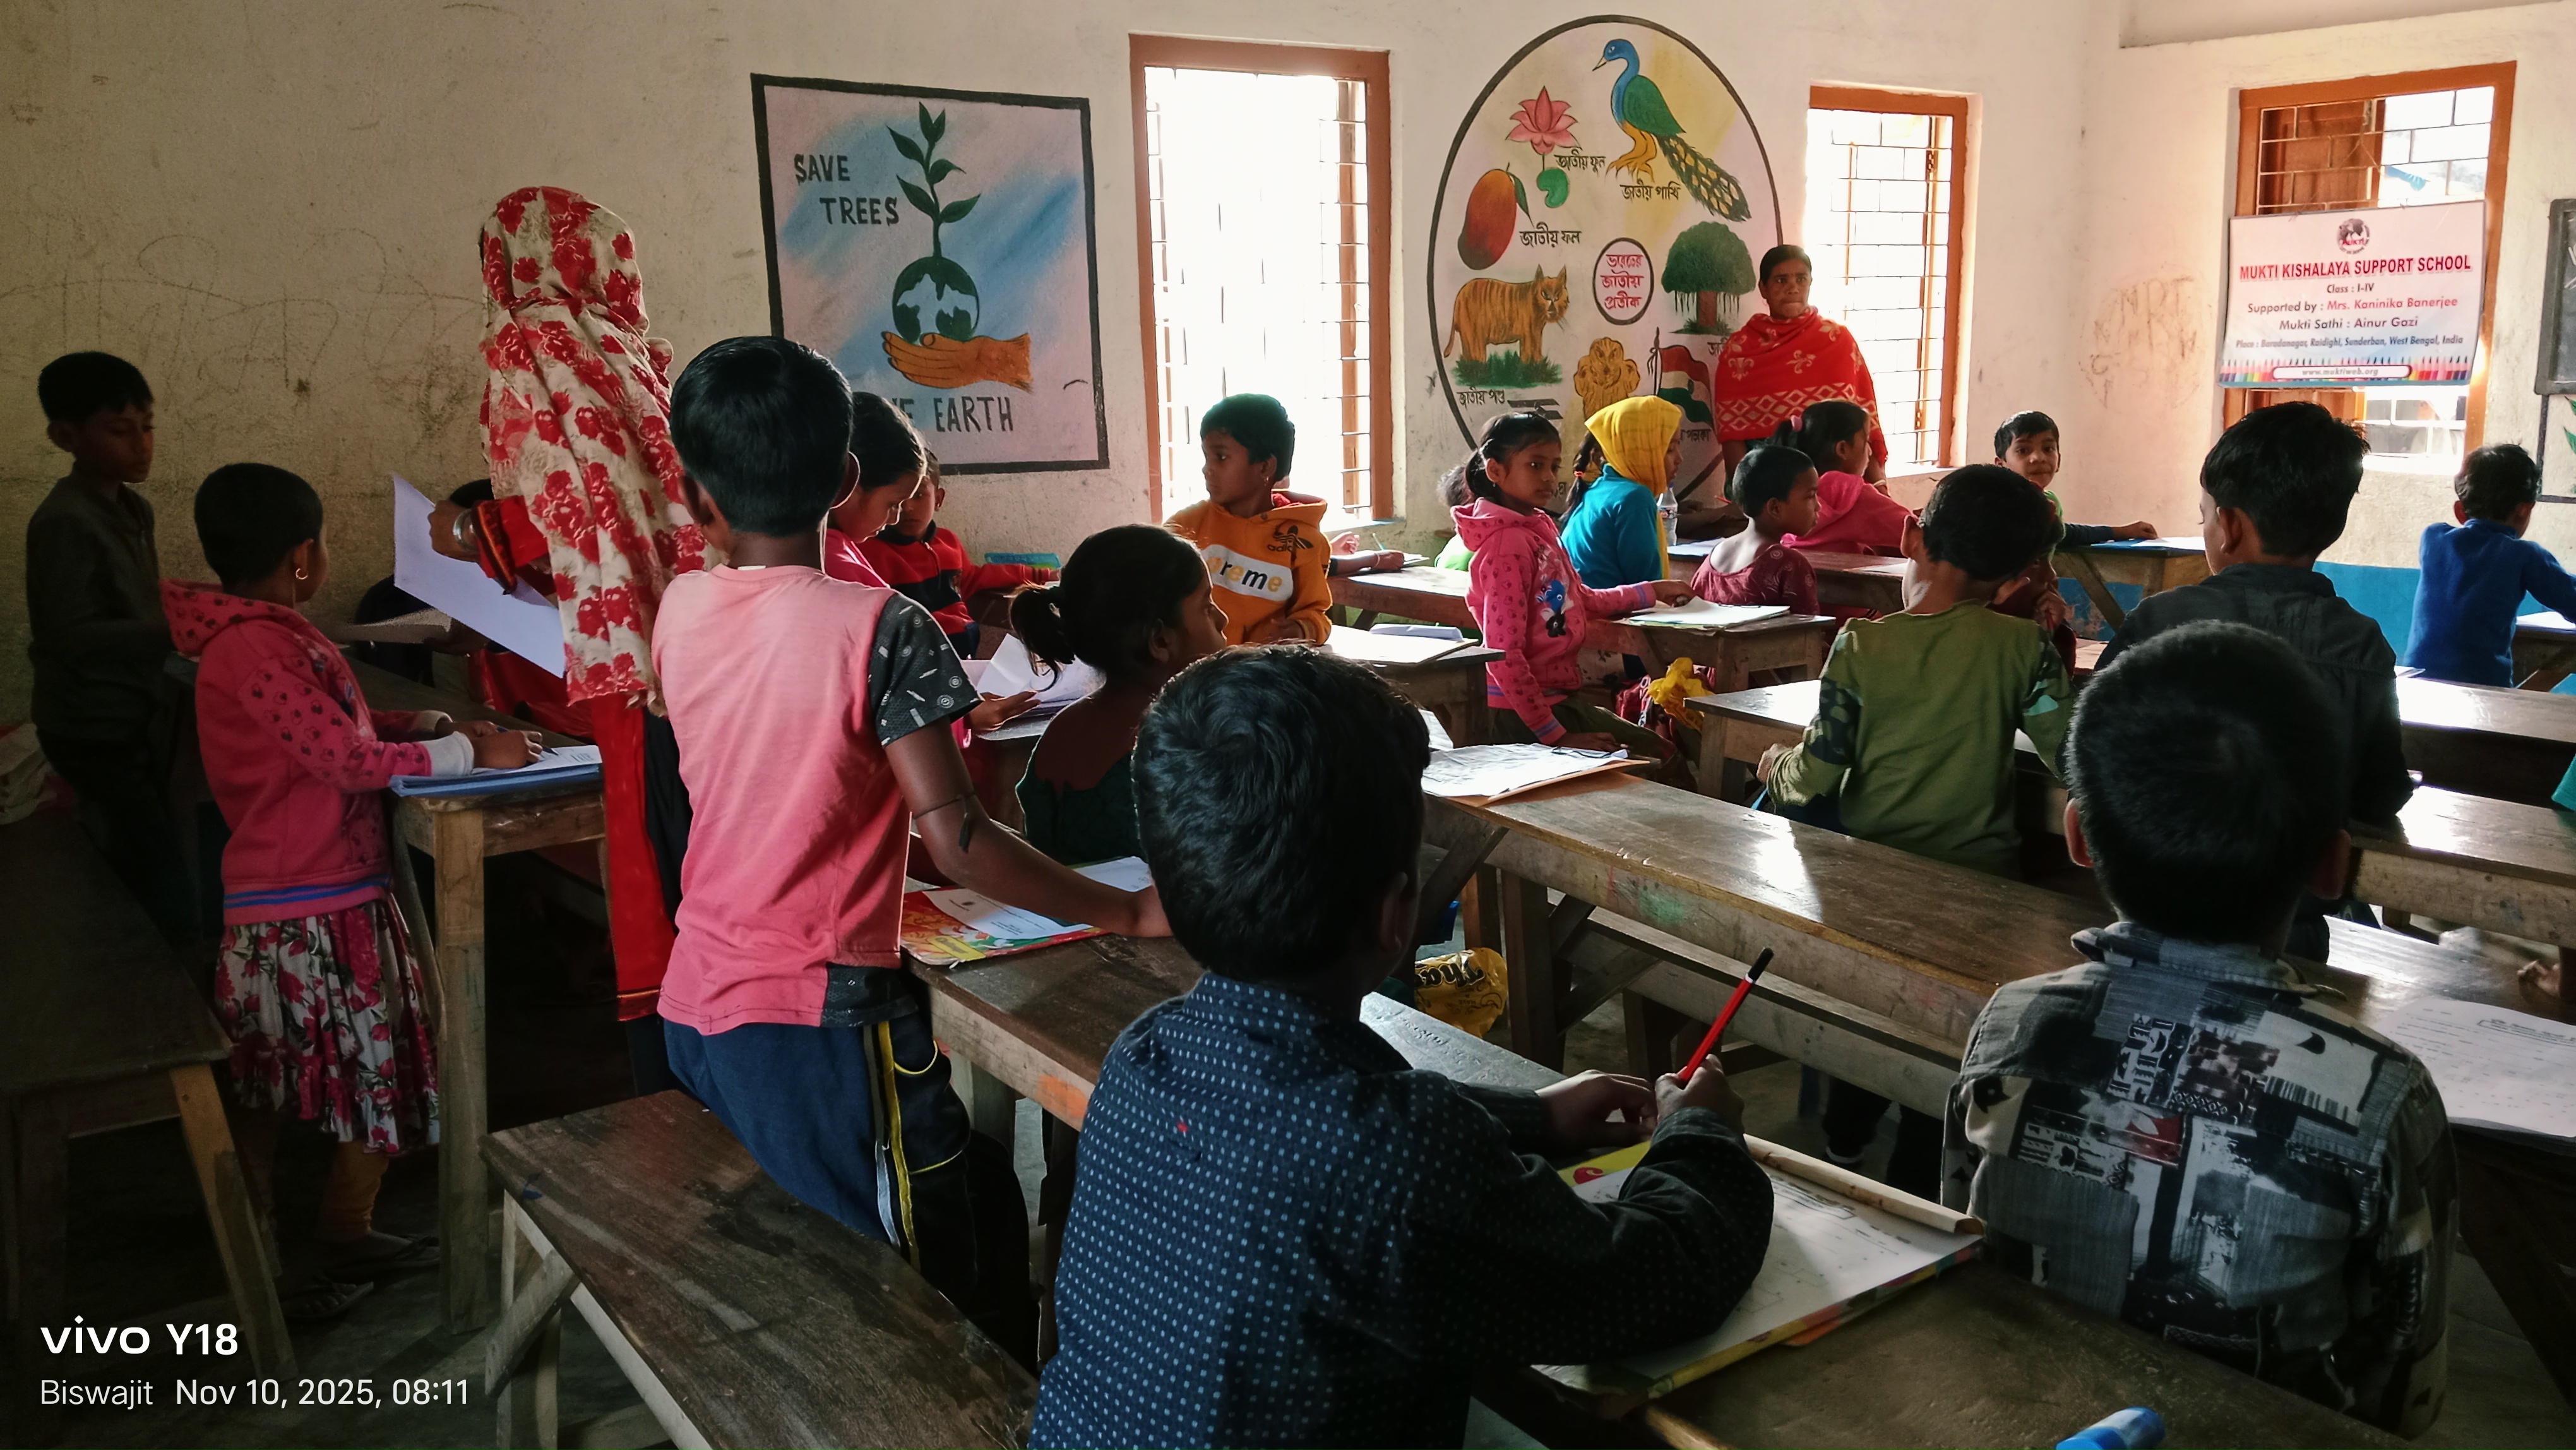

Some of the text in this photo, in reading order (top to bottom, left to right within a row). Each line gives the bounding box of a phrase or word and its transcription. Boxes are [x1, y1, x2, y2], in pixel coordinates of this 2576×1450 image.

[793, 153, 851, 186] SAVE
[1554, 148, 1589, 171] জাতীয়
[1619, 177, 1681, 203] জাতীয় পাখি
[819, 196, 900, 225] TREES
[1518, 221, 1581, 248] জাতীয় ফল
[1600, 268, 1645, 289] জাতীয়
[2239, 255, 2472, 280] MUKTI KISHALAYA SUPPORT SCHOOL
[1604, 290, 1642, 309] প্রতীক
[2327, 284, 2349, 294] Class
[2357, 282, 2375, 292] I-IV
[2247, 301, 2301, 315] Supported
[2304, 301, 2317, 314] by
[2327, 299, 2351, 310] Mrs.
[2407, 296, 2458, 309] Banerjee
[2279, 319, 2311, 330] Mukti
[2313, 318, 2343, 330] Sathi
[2354, 316, 2387, 328] Ainur
[2391, 316, 2419, 327] Gazi
[2236, 339, 2255, 349] Place
[2344, 335, 2387, 347] Sunderban,
[2389, 335, 2408, 345] West
[2410, 334, 2440, 347] Bengal,
[2442, 333, 2464, 345] India
[2301, 368, 2379, 376] www.muktiweb.org
[1456, 386, 1488, 410] জাতীয়
[934, 395, 1014, 434] EARTH
